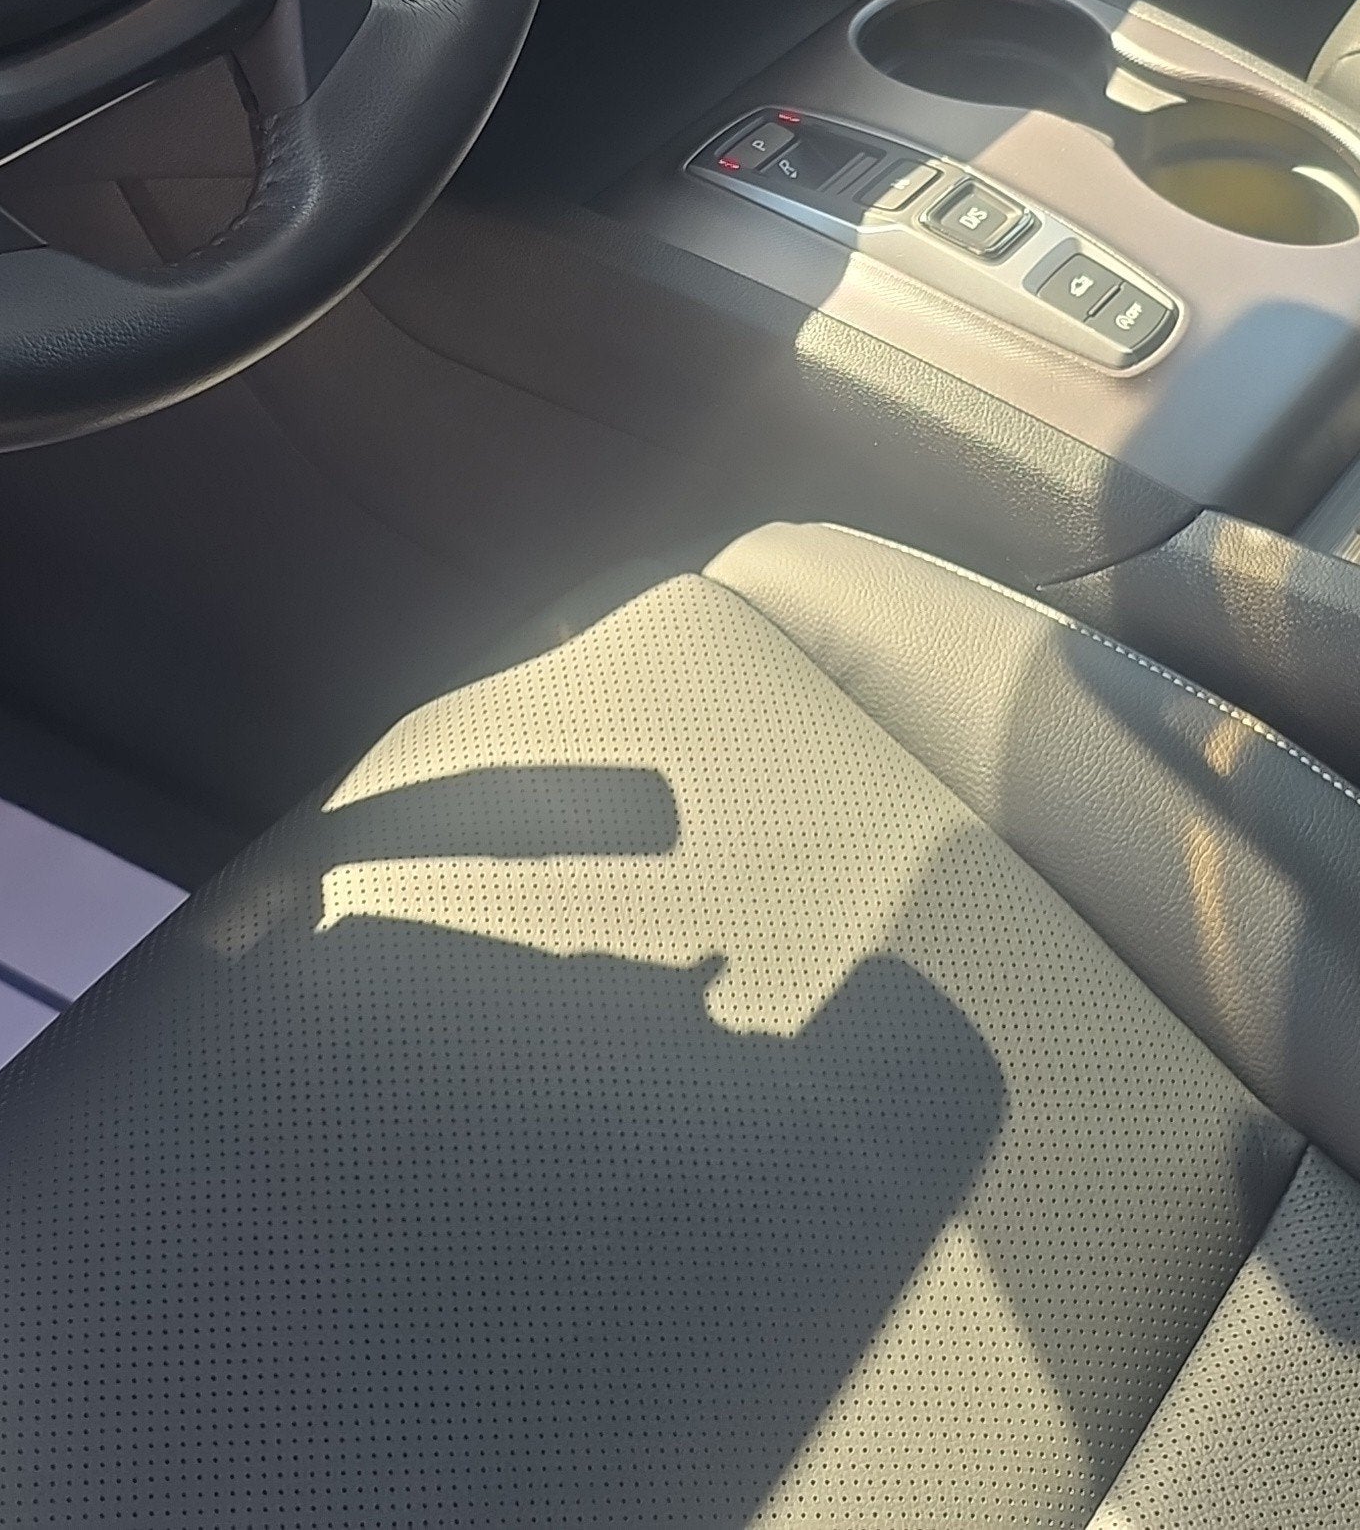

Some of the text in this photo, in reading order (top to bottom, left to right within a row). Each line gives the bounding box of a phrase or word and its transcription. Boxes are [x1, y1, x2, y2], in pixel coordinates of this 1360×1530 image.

[752, 139, 767, 153] P
[778, 159, 792, 175] R
[958, 206, 989, 230] D/S
